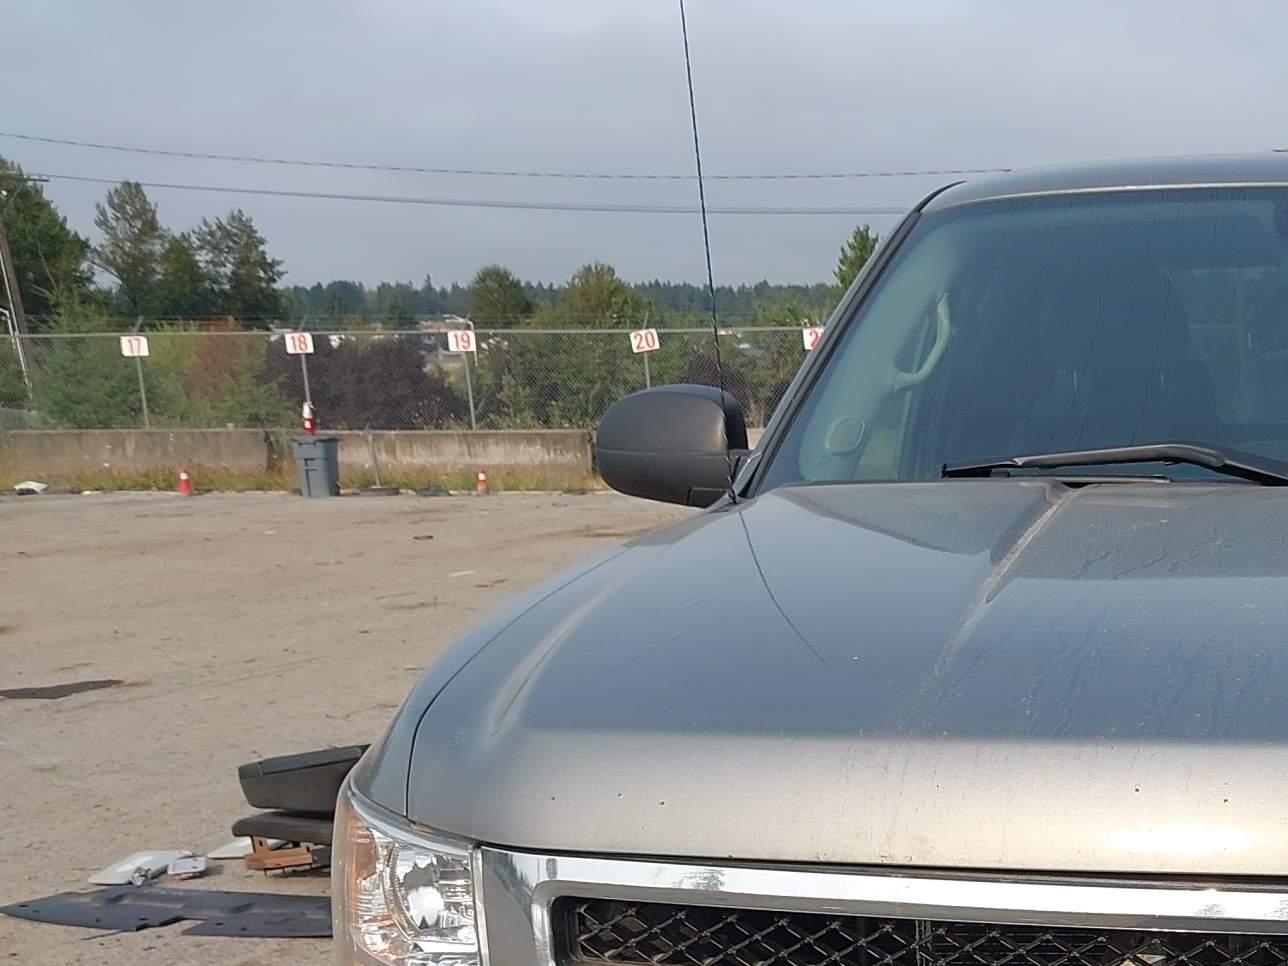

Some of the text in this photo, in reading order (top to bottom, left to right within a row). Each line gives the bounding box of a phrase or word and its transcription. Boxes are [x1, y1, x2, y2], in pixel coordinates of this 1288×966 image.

[128, 338, 141, 354] 17
[291, 334, 308, 351] 18
[454, 333, 471, 350] 19
[634, 331, 656, 351] 20
